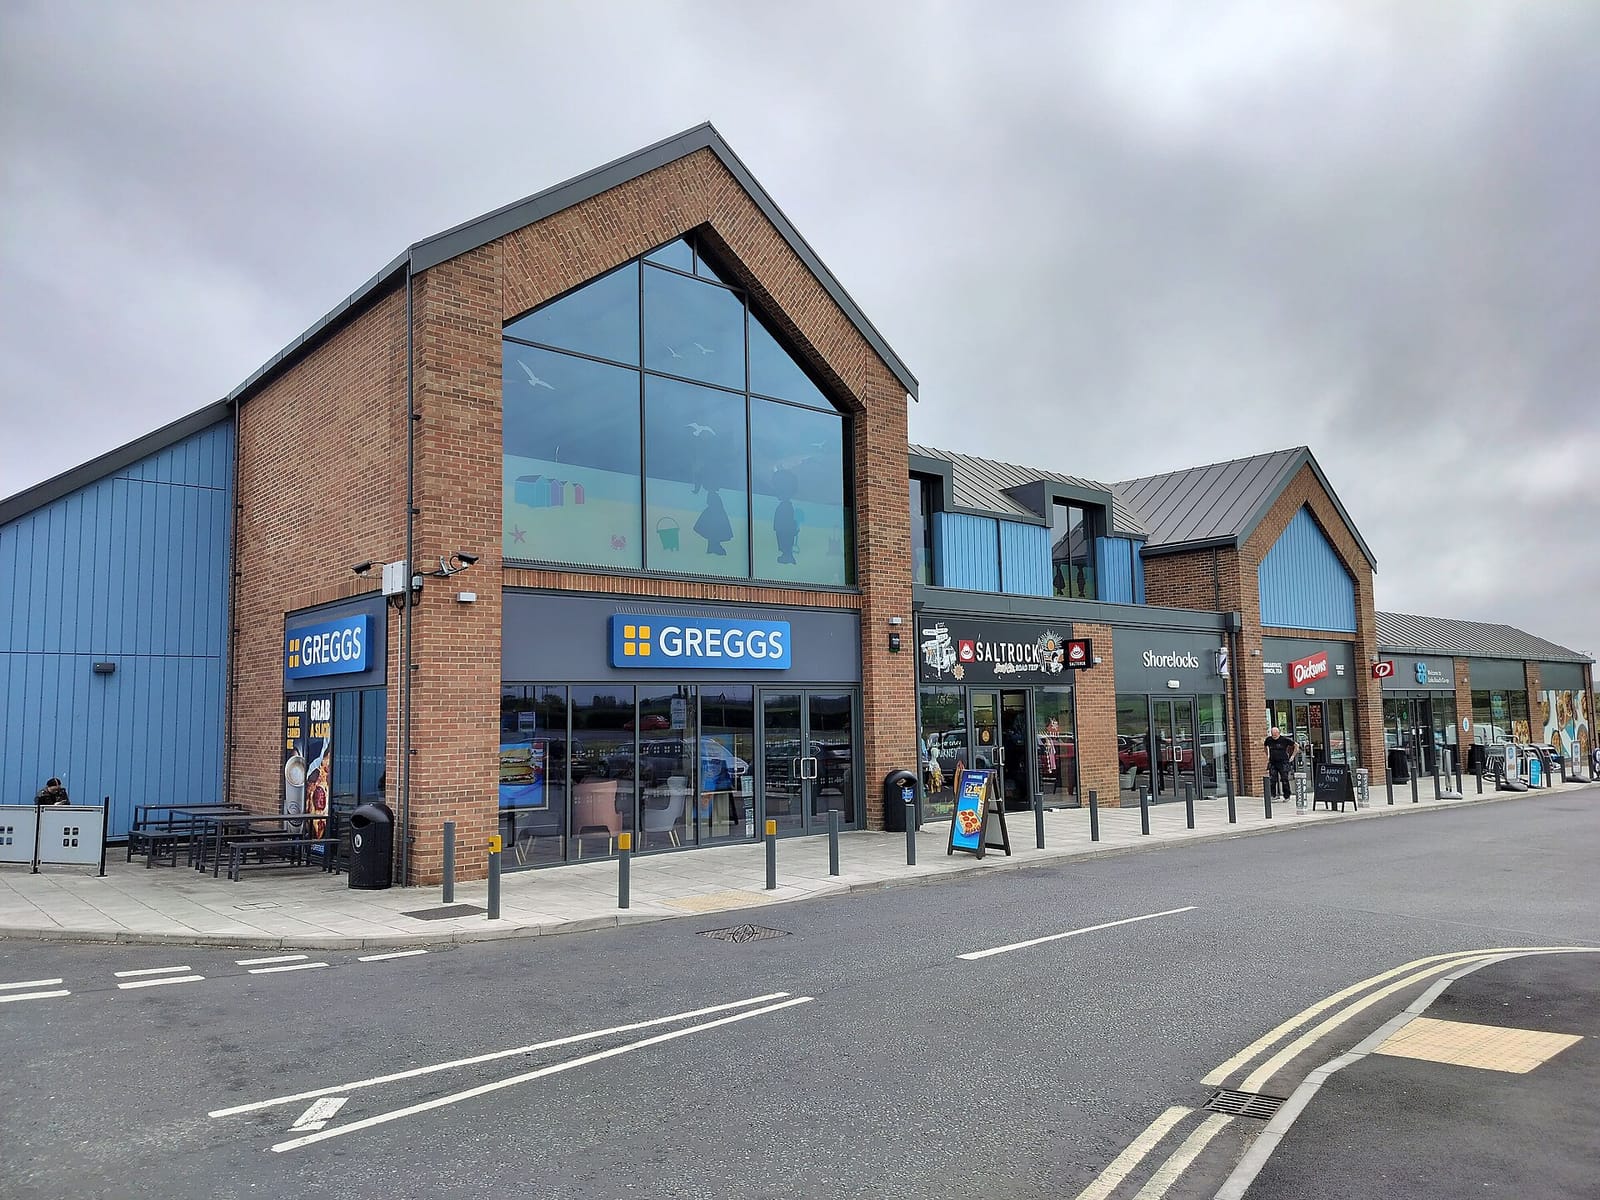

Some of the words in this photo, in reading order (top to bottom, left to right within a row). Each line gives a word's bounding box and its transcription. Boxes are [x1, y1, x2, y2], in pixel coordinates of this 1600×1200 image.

[302, 626, 362, 666] GREGGS
[659, 626, 783, 659] GREGGS
[976, 641, 1041, 663] SALTROCK
[1142, 649, 1199, 669] Shorelocks
[310, 699, 331, 721] GRAB
